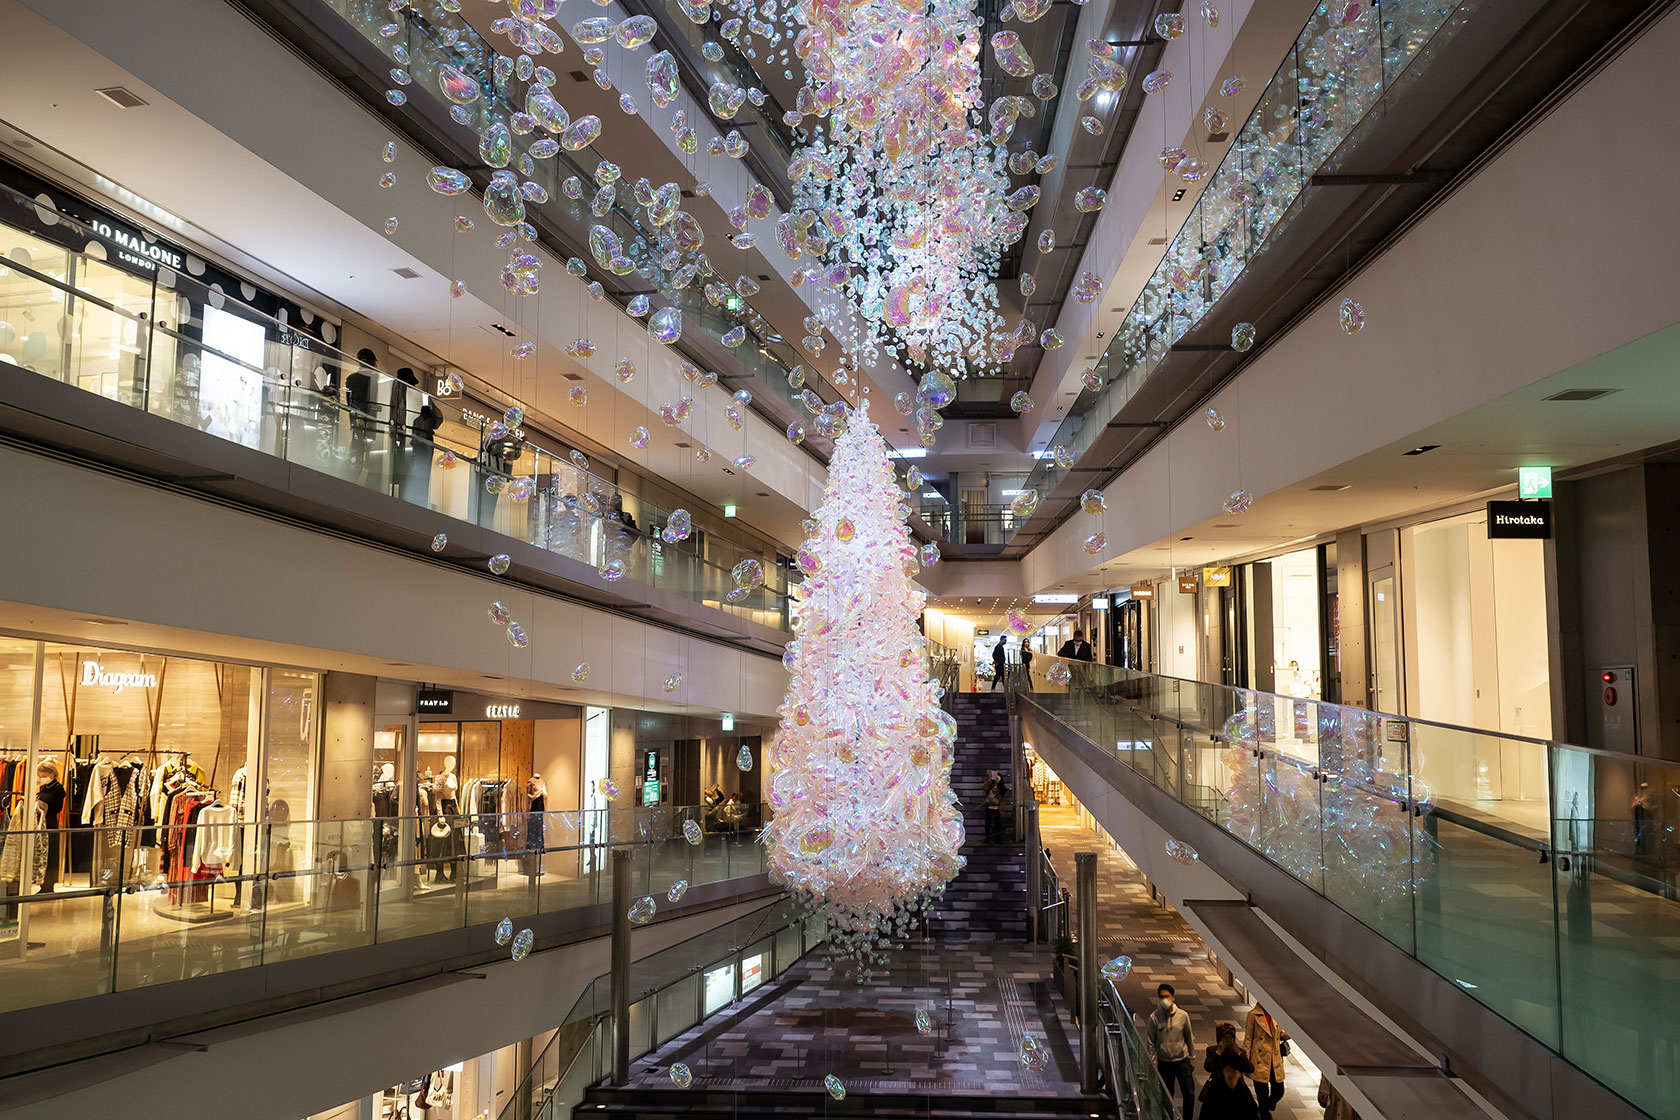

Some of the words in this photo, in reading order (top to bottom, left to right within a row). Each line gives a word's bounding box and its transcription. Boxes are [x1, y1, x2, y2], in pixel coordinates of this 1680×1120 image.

[114, 229, 181, 269] MALONE
[1496, 515, 1544, 525] Hirotaka
[80, 661, 157, 695] Diagram
